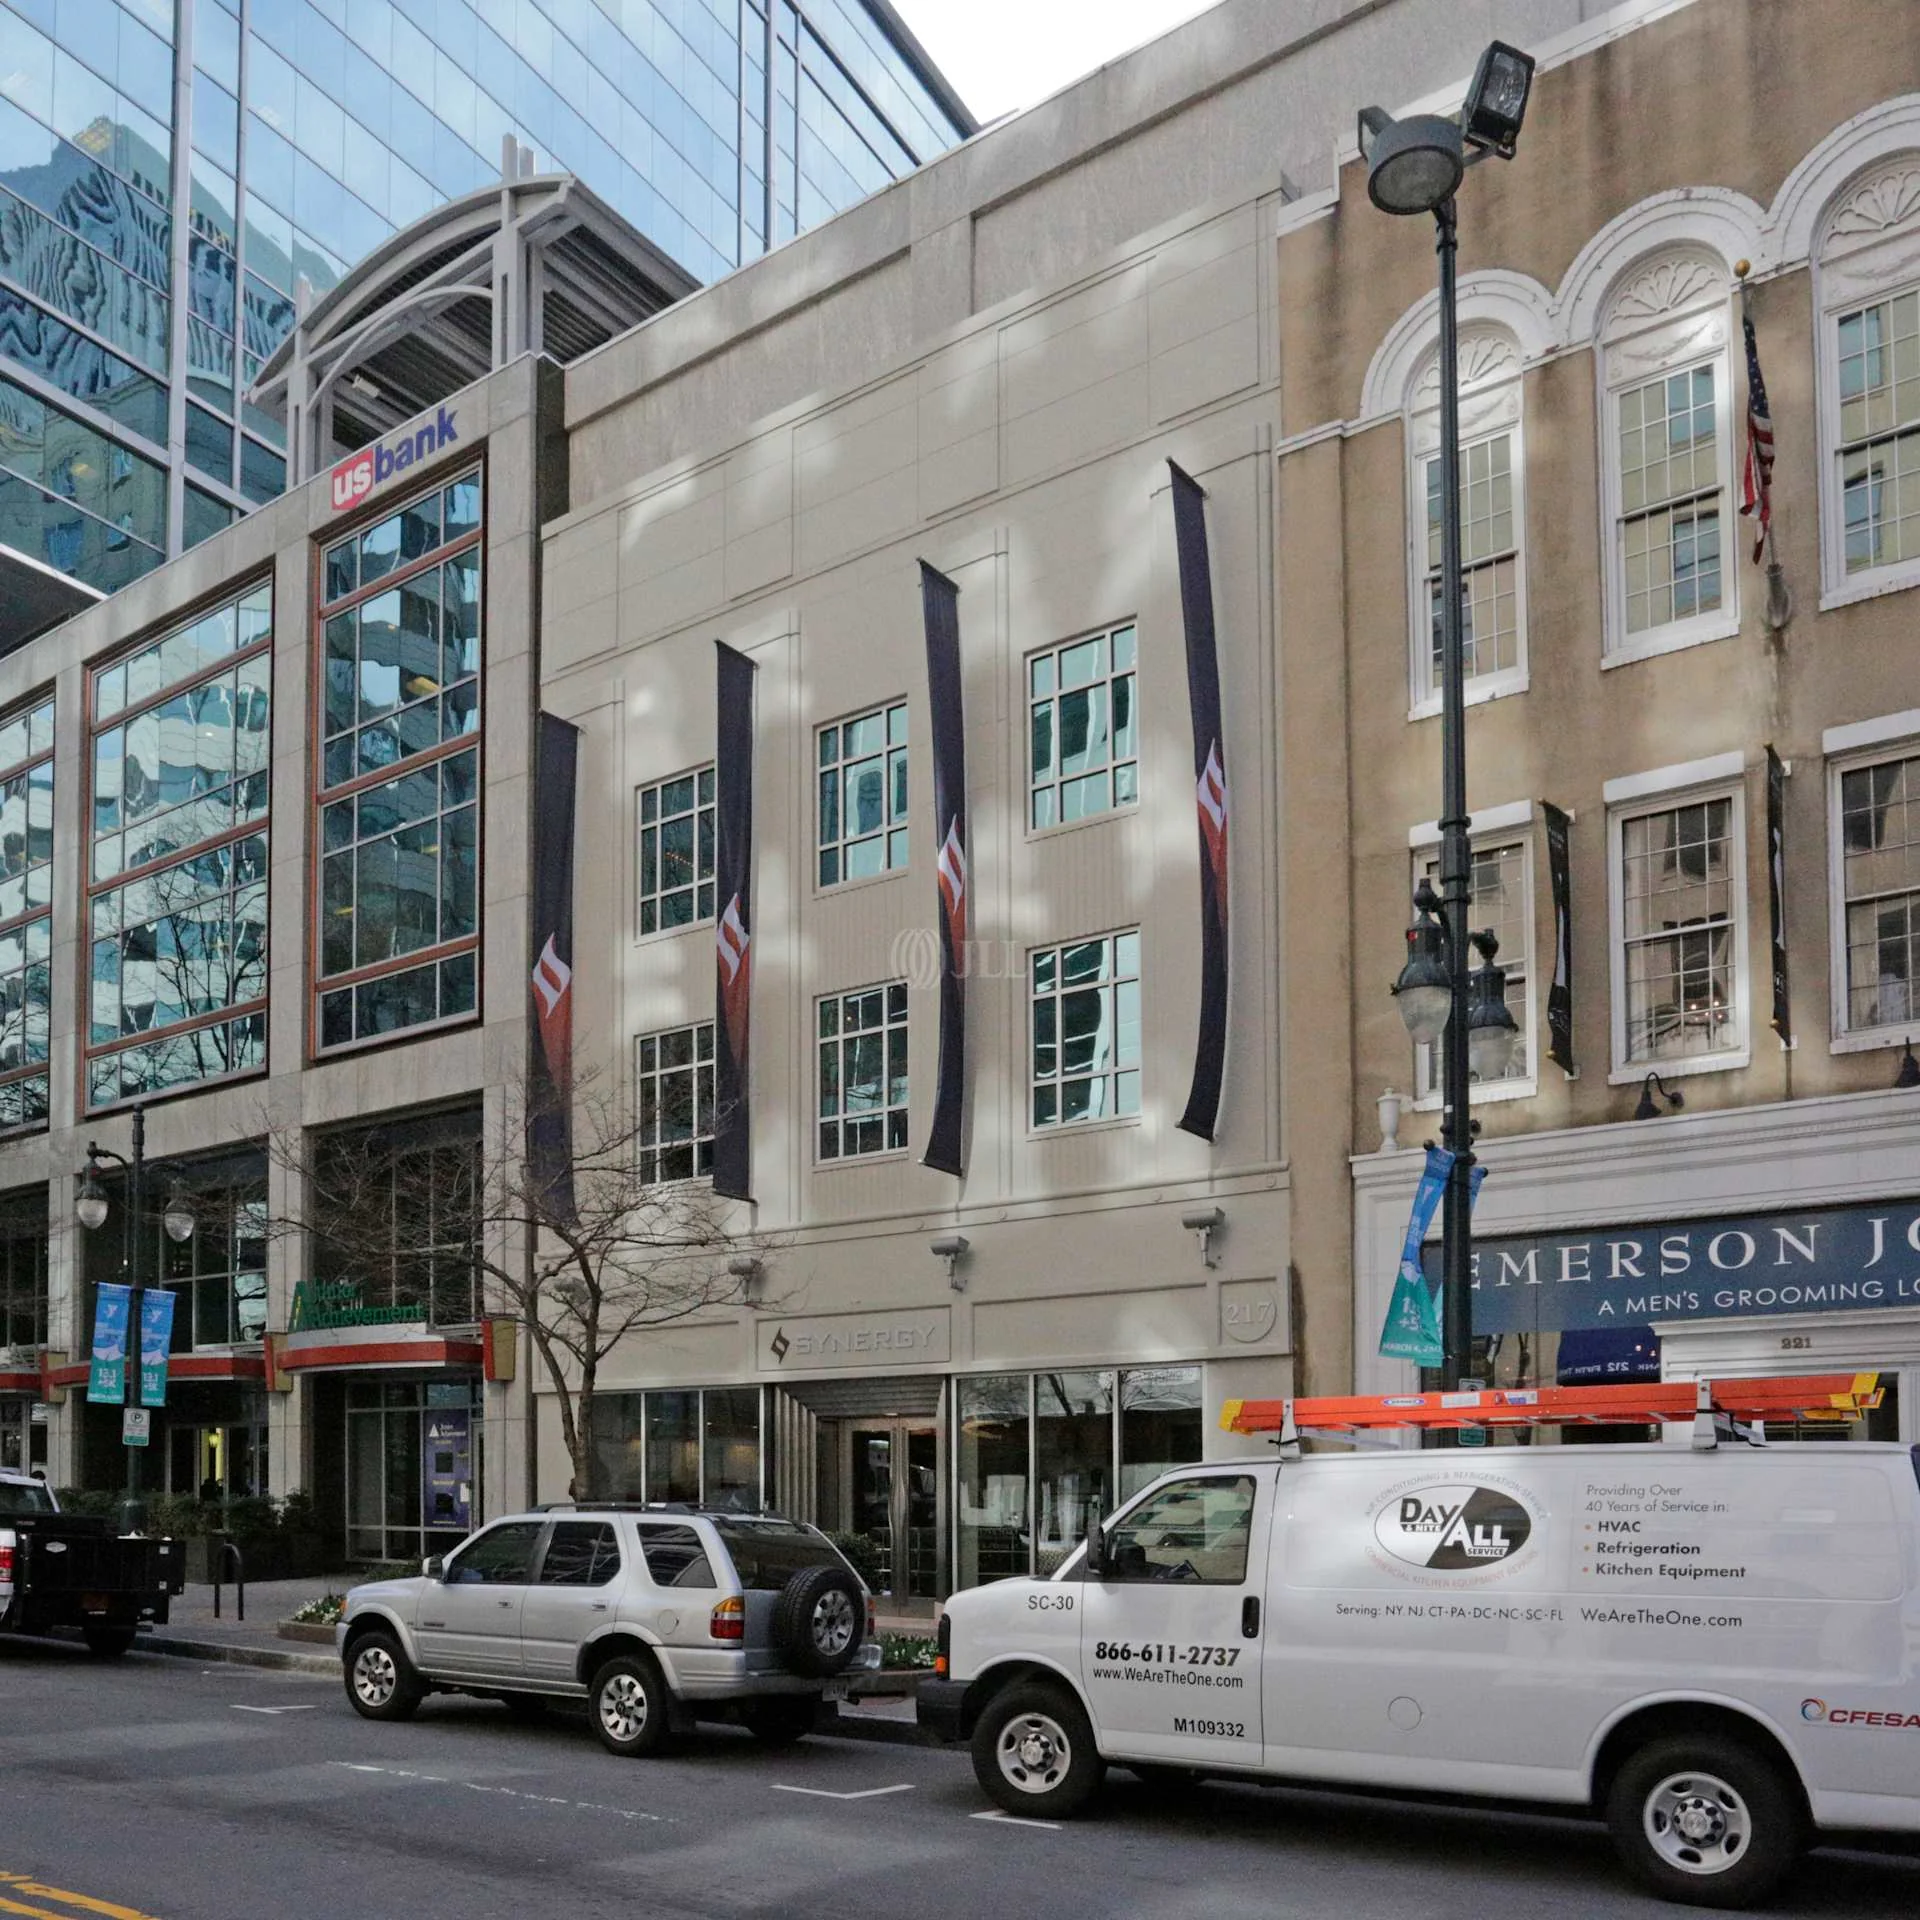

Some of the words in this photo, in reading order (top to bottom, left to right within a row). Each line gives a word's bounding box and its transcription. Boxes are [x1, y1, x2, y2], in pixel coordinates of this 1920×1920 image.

[1471, 1224, 1821, 1290] MERSON
[1863, 1217, 1920, 1269] J
[1598, 1298, 1615, 1316] A
[1625, 1291, 1699, 1314] MEN'S
[1714, 1281, 1884, 1308] GROOMING
[1227, 1302, 1273, 1326] 217
[797, 1326, 936, 1356] SYNERGY
[1586, 1484, 1645, 1499] Providing
[1649, 1484, 1683, 1497] Over
[1585, 1501, 1603, 1513] 40
[1607, 1501, 1641, 1513] Years
[1644, 1499, 1658, 1513] of
[1661, 1500, 1709, 1513] Service
[1598, 1521, 1641, 1533] HVAC
[1467, 1548, 1504, 1556] SERVICE
[1597, 1541, 1701, 1557] Refrigeration
[1596, 1563, 1653, 1576] Kitchen
[1659, 1563, 1746, 1580] Equipment
[1028, 1595, 1074, 1611] SC-30
[1336, 1604, 1381, 1619] Serving:
[1581, 1607, 1743, 1627] WeAreTheOne.com
[1095, 1642, 1241, 1667] 866-611-2737
[1093, 1668, 1243, 1688] www.WeAreTheOne.com
[1174, 1718, 1245, 1738] M109332
[1829, 1709, 1920, 1728] CFESA
